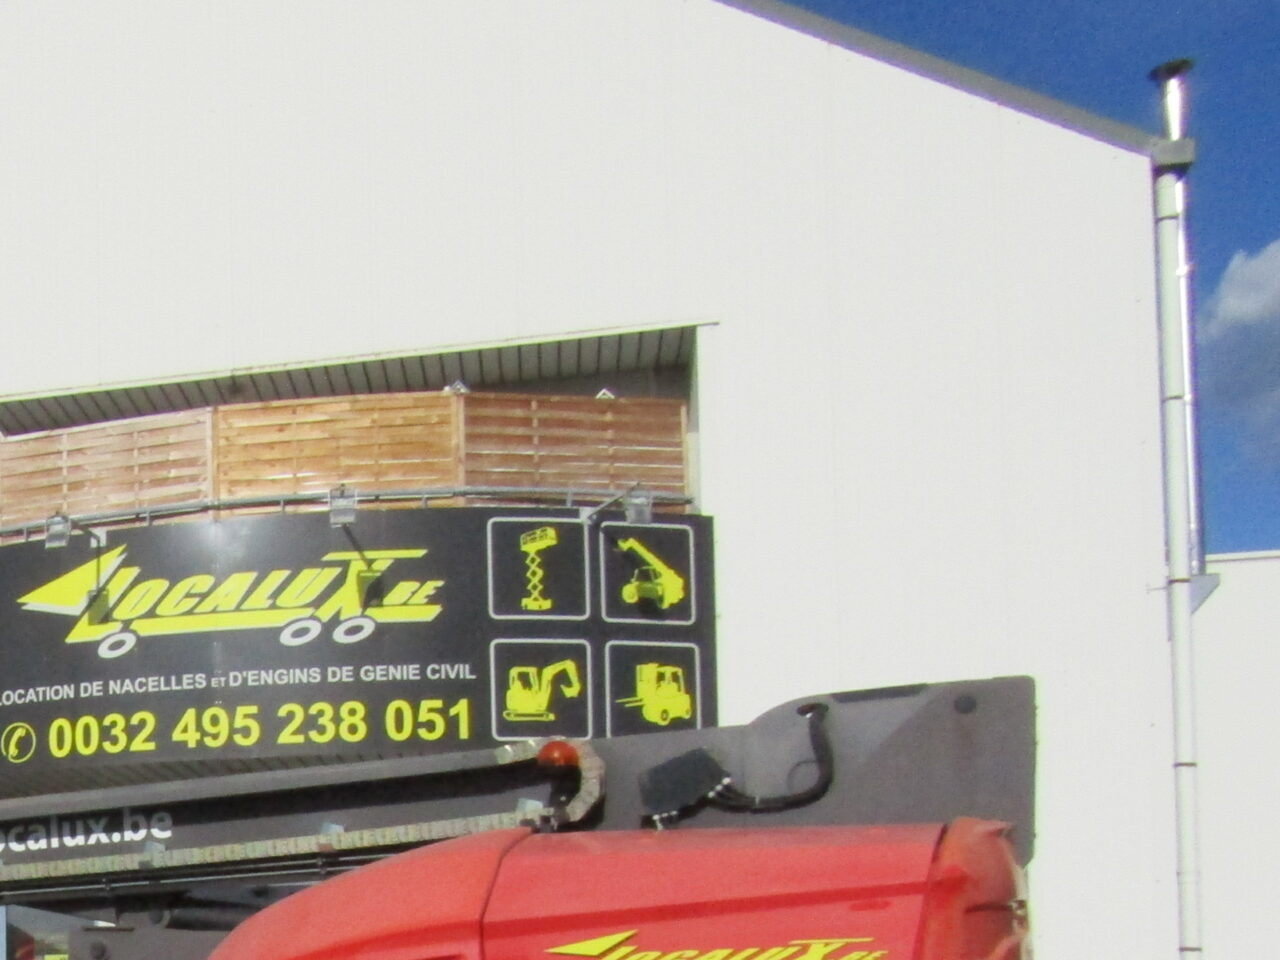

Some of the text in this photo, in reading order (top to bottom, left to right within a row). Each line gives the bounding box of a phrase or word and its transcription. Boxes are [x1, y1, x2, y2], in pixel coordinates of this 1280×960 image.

[80, 681, 103, 698] DE
[109, 673, 207, 695] NACELLES
[210, 676, 227, 688] ET
[229, 667, 321, 687] D'ENGINS
[327, 666, 354, 682] DE
[360, 664, 420, 681] GENIE
[426, 663, 476, 680] CIVIL
[48, 699, 469, 758] 0032 495 238 051
